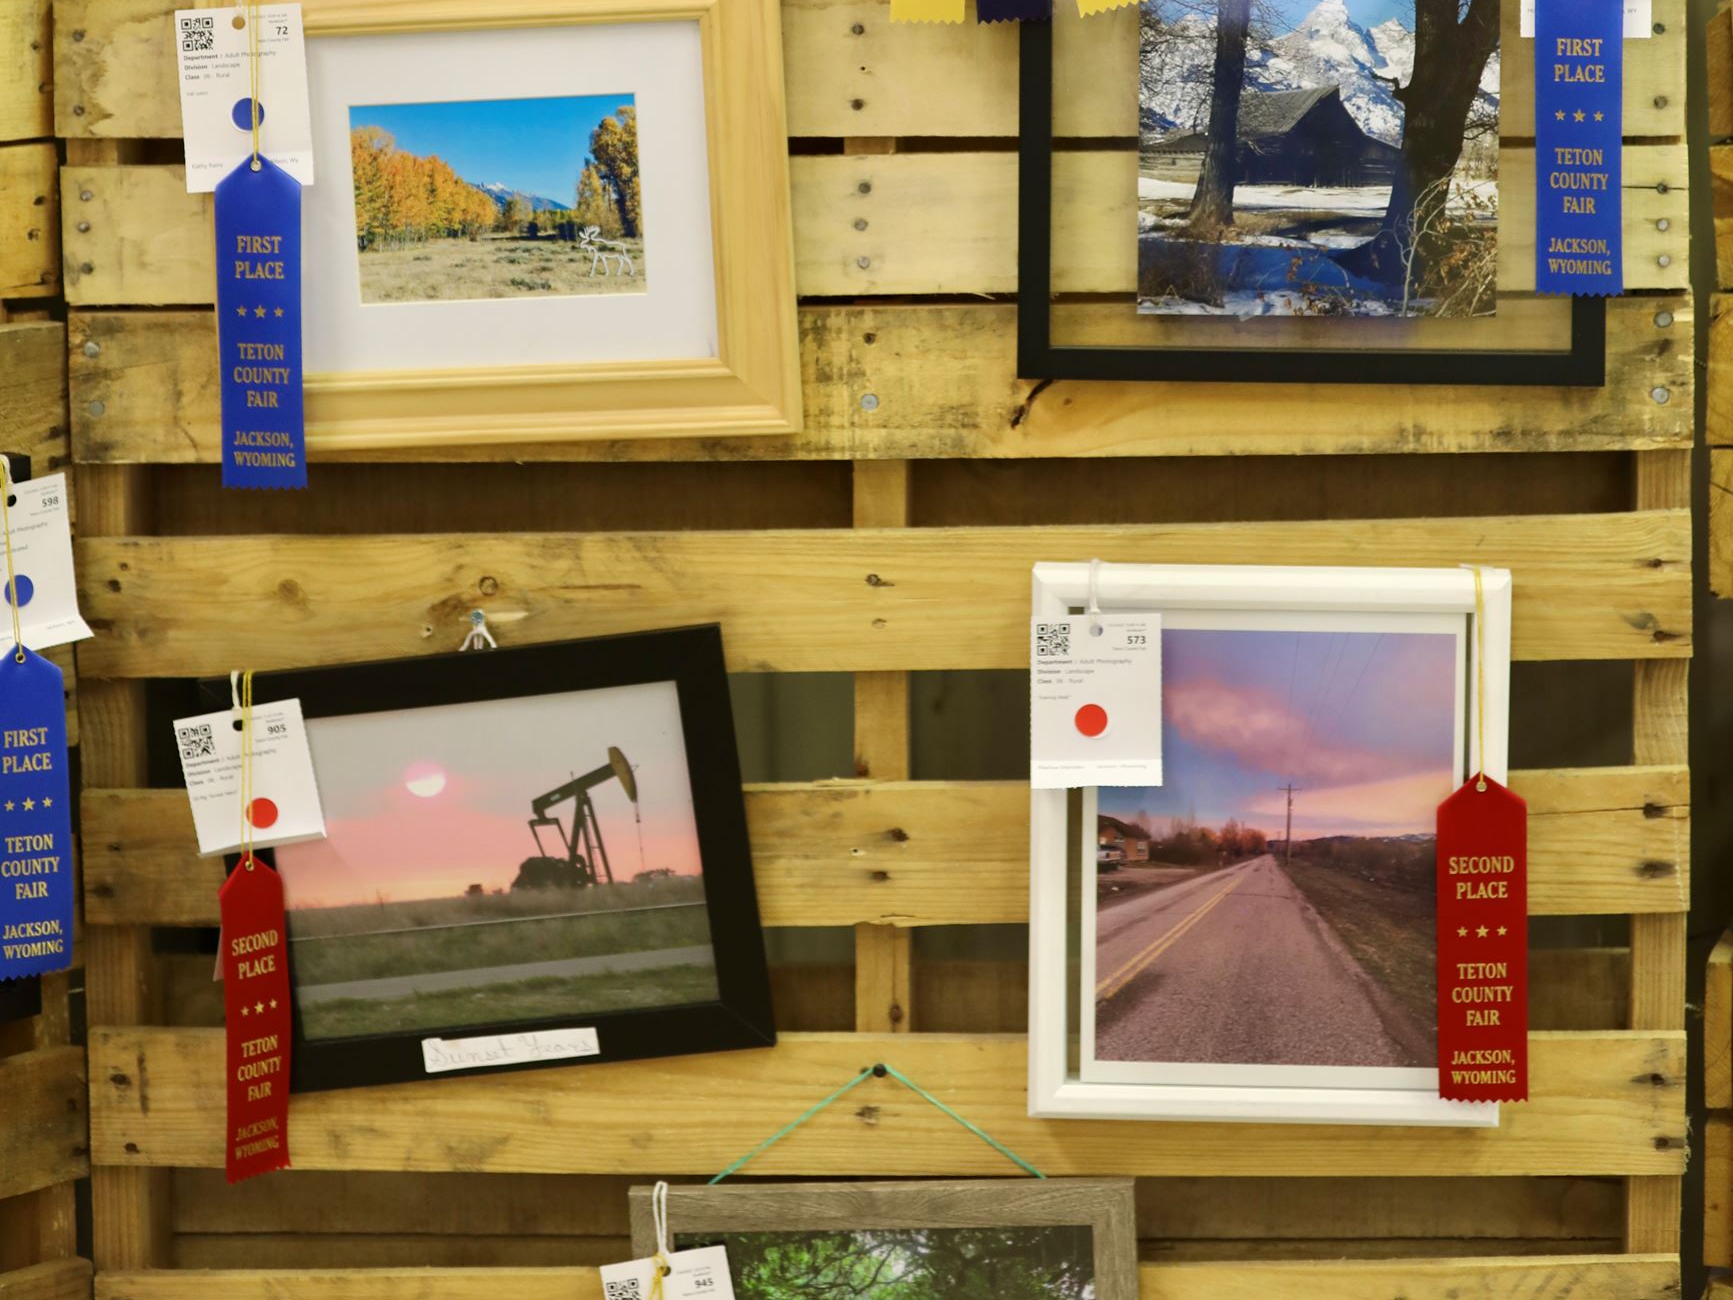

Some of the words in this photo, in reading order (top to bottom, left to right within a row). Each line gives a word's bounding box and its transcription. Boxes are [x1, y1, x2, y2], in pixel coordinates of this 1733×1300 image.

[276, 26, 288, 35] 72
[1556, 38, 1603, 57] FIRST
[1554, 64, 1605, 83] PLACE
[1555, 147, 1603, 165] TETON
[1550, 172, 1608, 190] COUNTY
[1563, 196, 1596, 214] FAIR
[236, 235, 282, 254] FIRST
[1549, 237, 1611, 256] JACKSON,
[235, 261, 284, 279] PLACE
[1548, 259, 1611, 275] WYOMING
[237, 343, 284, 361] TETON
[234, 367, 290, 384] COUNTY
[246, 391, 278, 408] FAIR
[234, 431, 294, 448] JACKSON,
[234, 451, 296, 468] WYOMING
[42, 497, 59, 508] 598
[1127, 636, 1146, 644] 573
[4, 727, 48, 749] FIRST
[267, 724, 286, 734] 905
[2, 752, 52, 774] PLACE
[5, 833, 53, 854] TETON
[1, 856, 60, 877] COUNTY
[1449, 856, 1515, 874] SECOND
[15, 881, 49, 900] FAIR
[1456, 881, 1508, 900] PLACE
[3, 919, 63, 940] JACKSON,
[3, 939, 64, 960] WYOMING
[231, 929, 278, 957] SECOND
[238, 954, 276, 980] PLACE
[1456, 962, 1507, 980] TETON
[1452, 985, 1514, 1004] COUNTY
[1466, 1010, 1501, 1027] FAIR
[241, 1035, 278, 1058] TETON
[428, 1037, 513, 1067] Sunset
[1451, 1050, 1515, 1066] JACKSON,
[237, 1056, 282, 1082] COUNTY
[1451, 1070, 1516, 1085] WYOMING
[248, 1082, 272, 1102] FAIR
[236, 1116, 278, 1142] JACKSON,
[234, 1135, 279, 1161] WYOMING
[694, 1278, 714, 1288] 945
